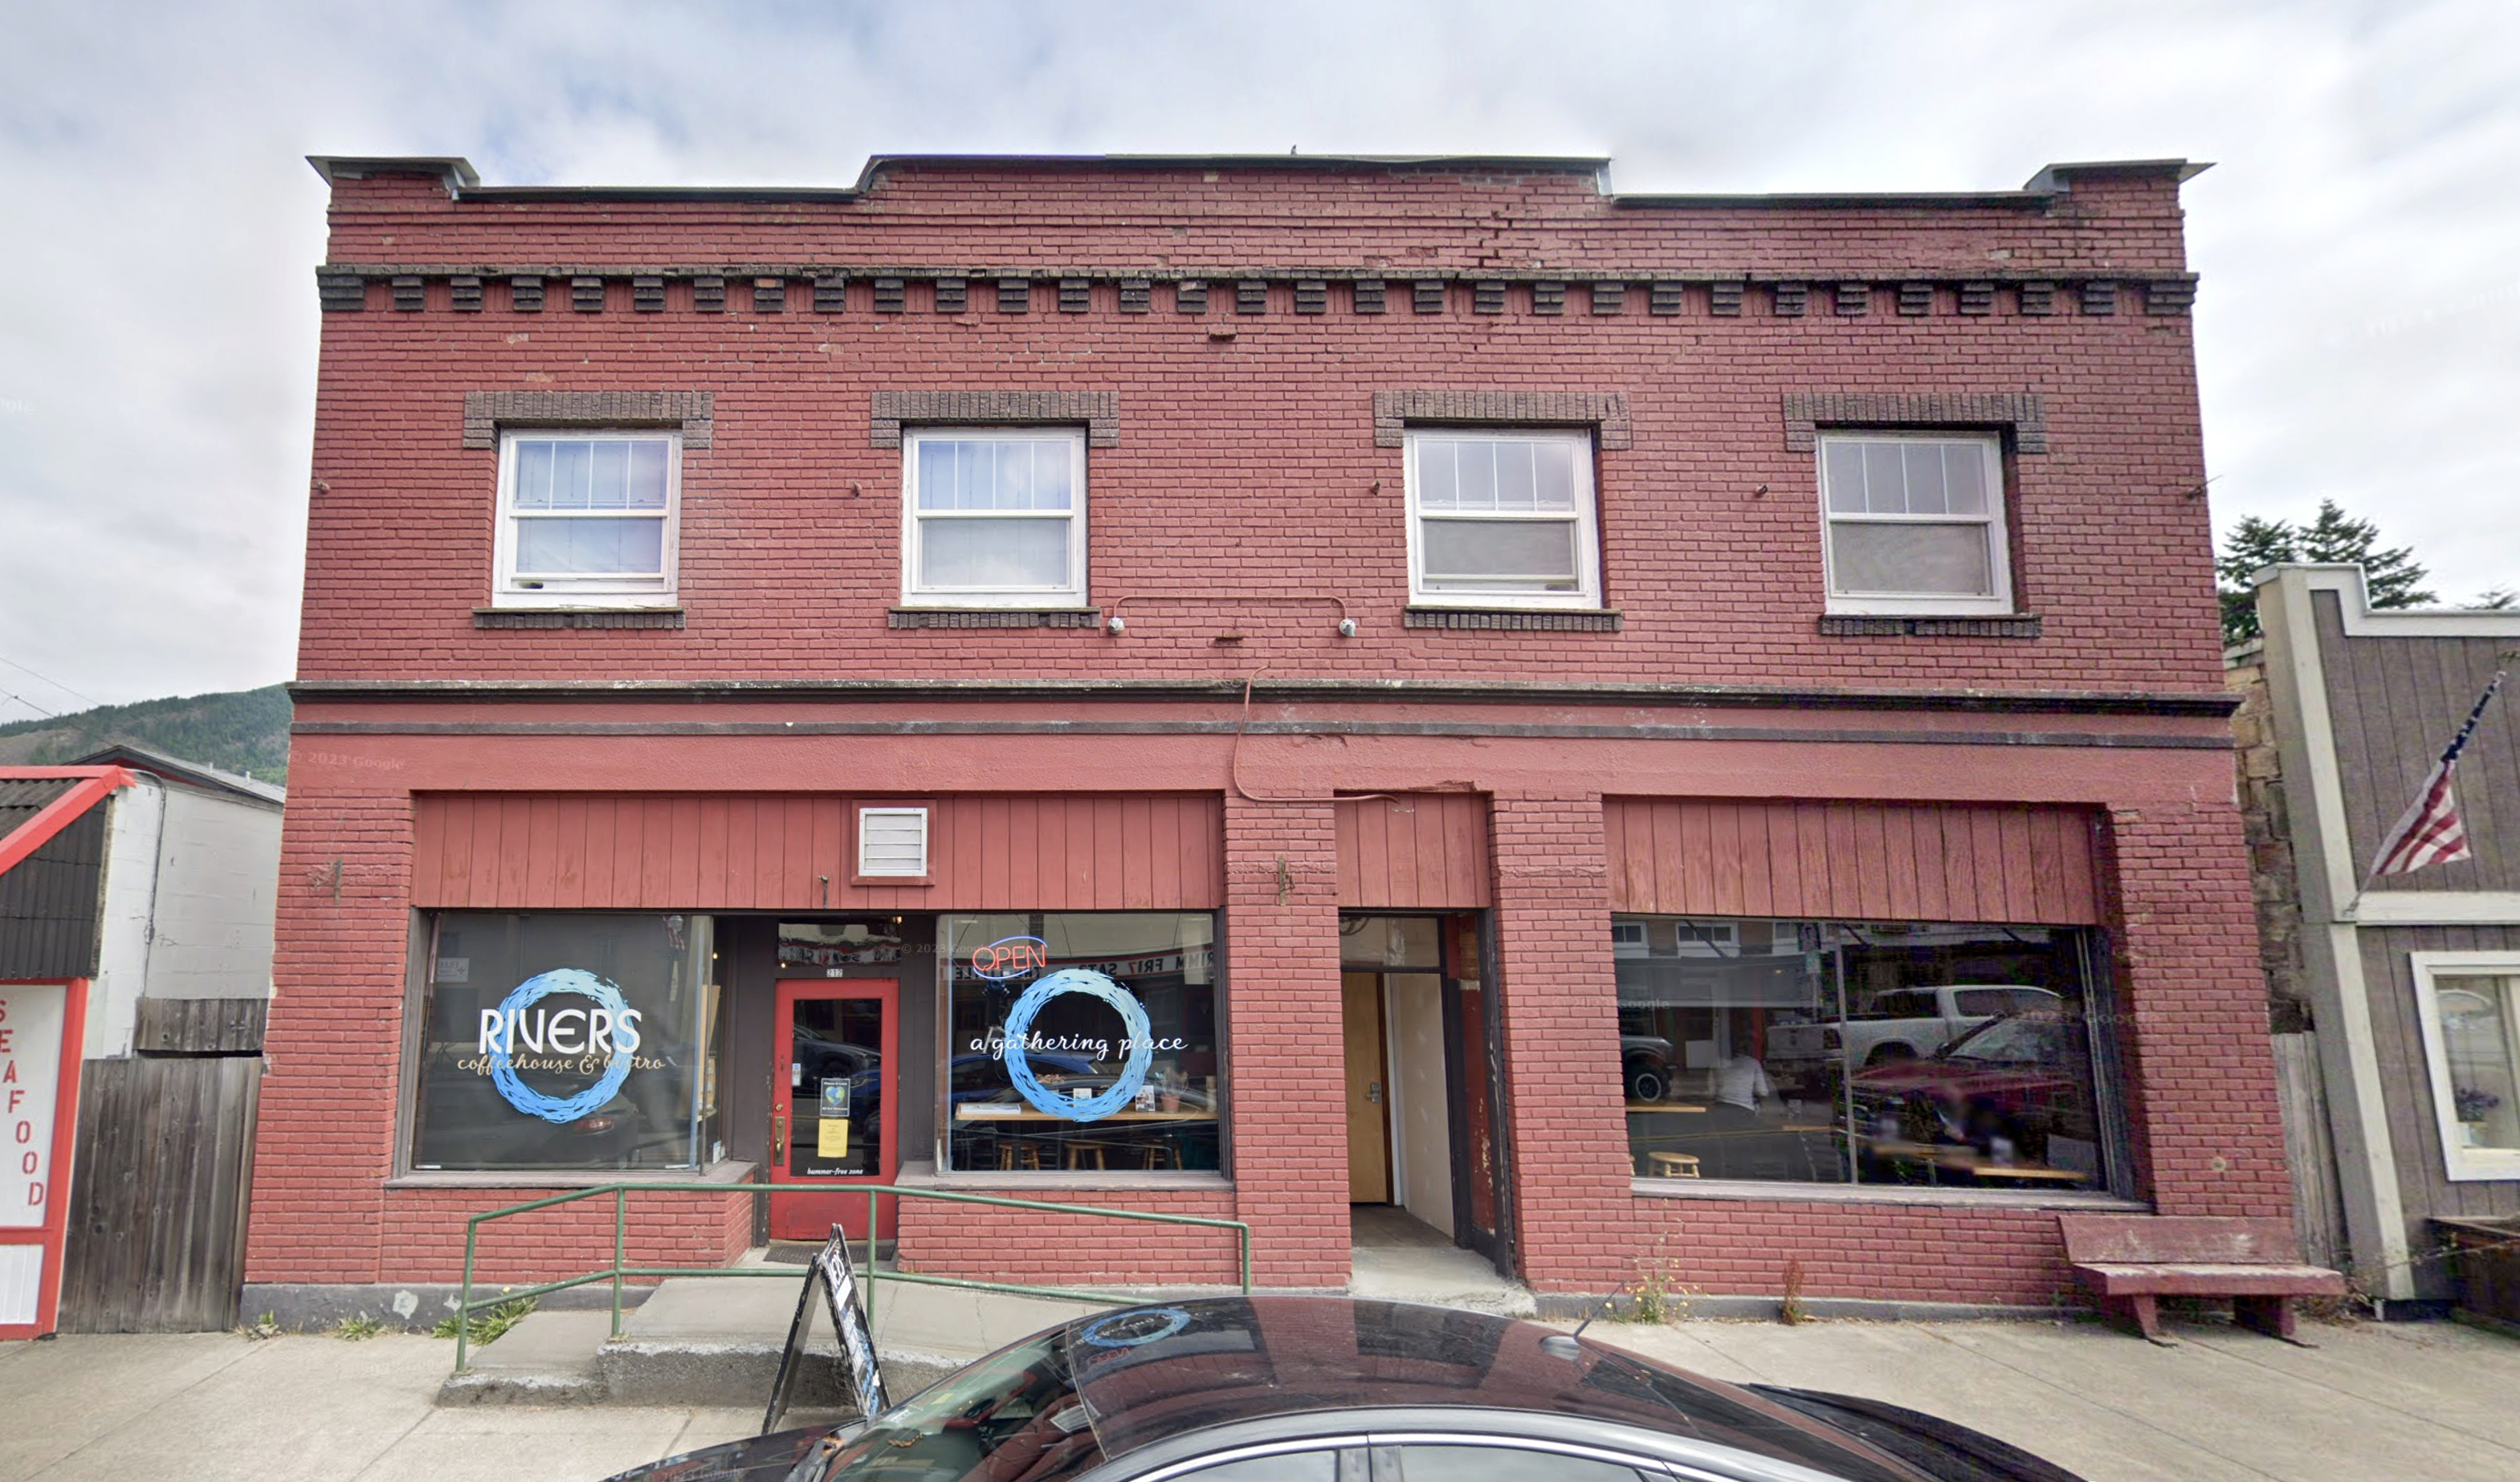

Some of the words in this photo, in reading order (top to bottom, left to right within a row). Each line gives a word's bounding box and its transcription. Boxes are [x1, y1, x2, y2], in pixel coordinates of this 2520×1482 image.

[973, 944, 1047, 971] OPEN
[828, 969, 842, 977] 212
[479, 1008, 642, 1054] RIVERS
[969, 1037, 986, 1051] a
[992, 1030, 1109, 1061] gathering
[1118, 1030, 1189, 1060] place
[457, 1053, 574, 1076] coffeehouse
[579, 1054, 601, 1075] &
[807, 1167, 847, 1175] bummer-free
